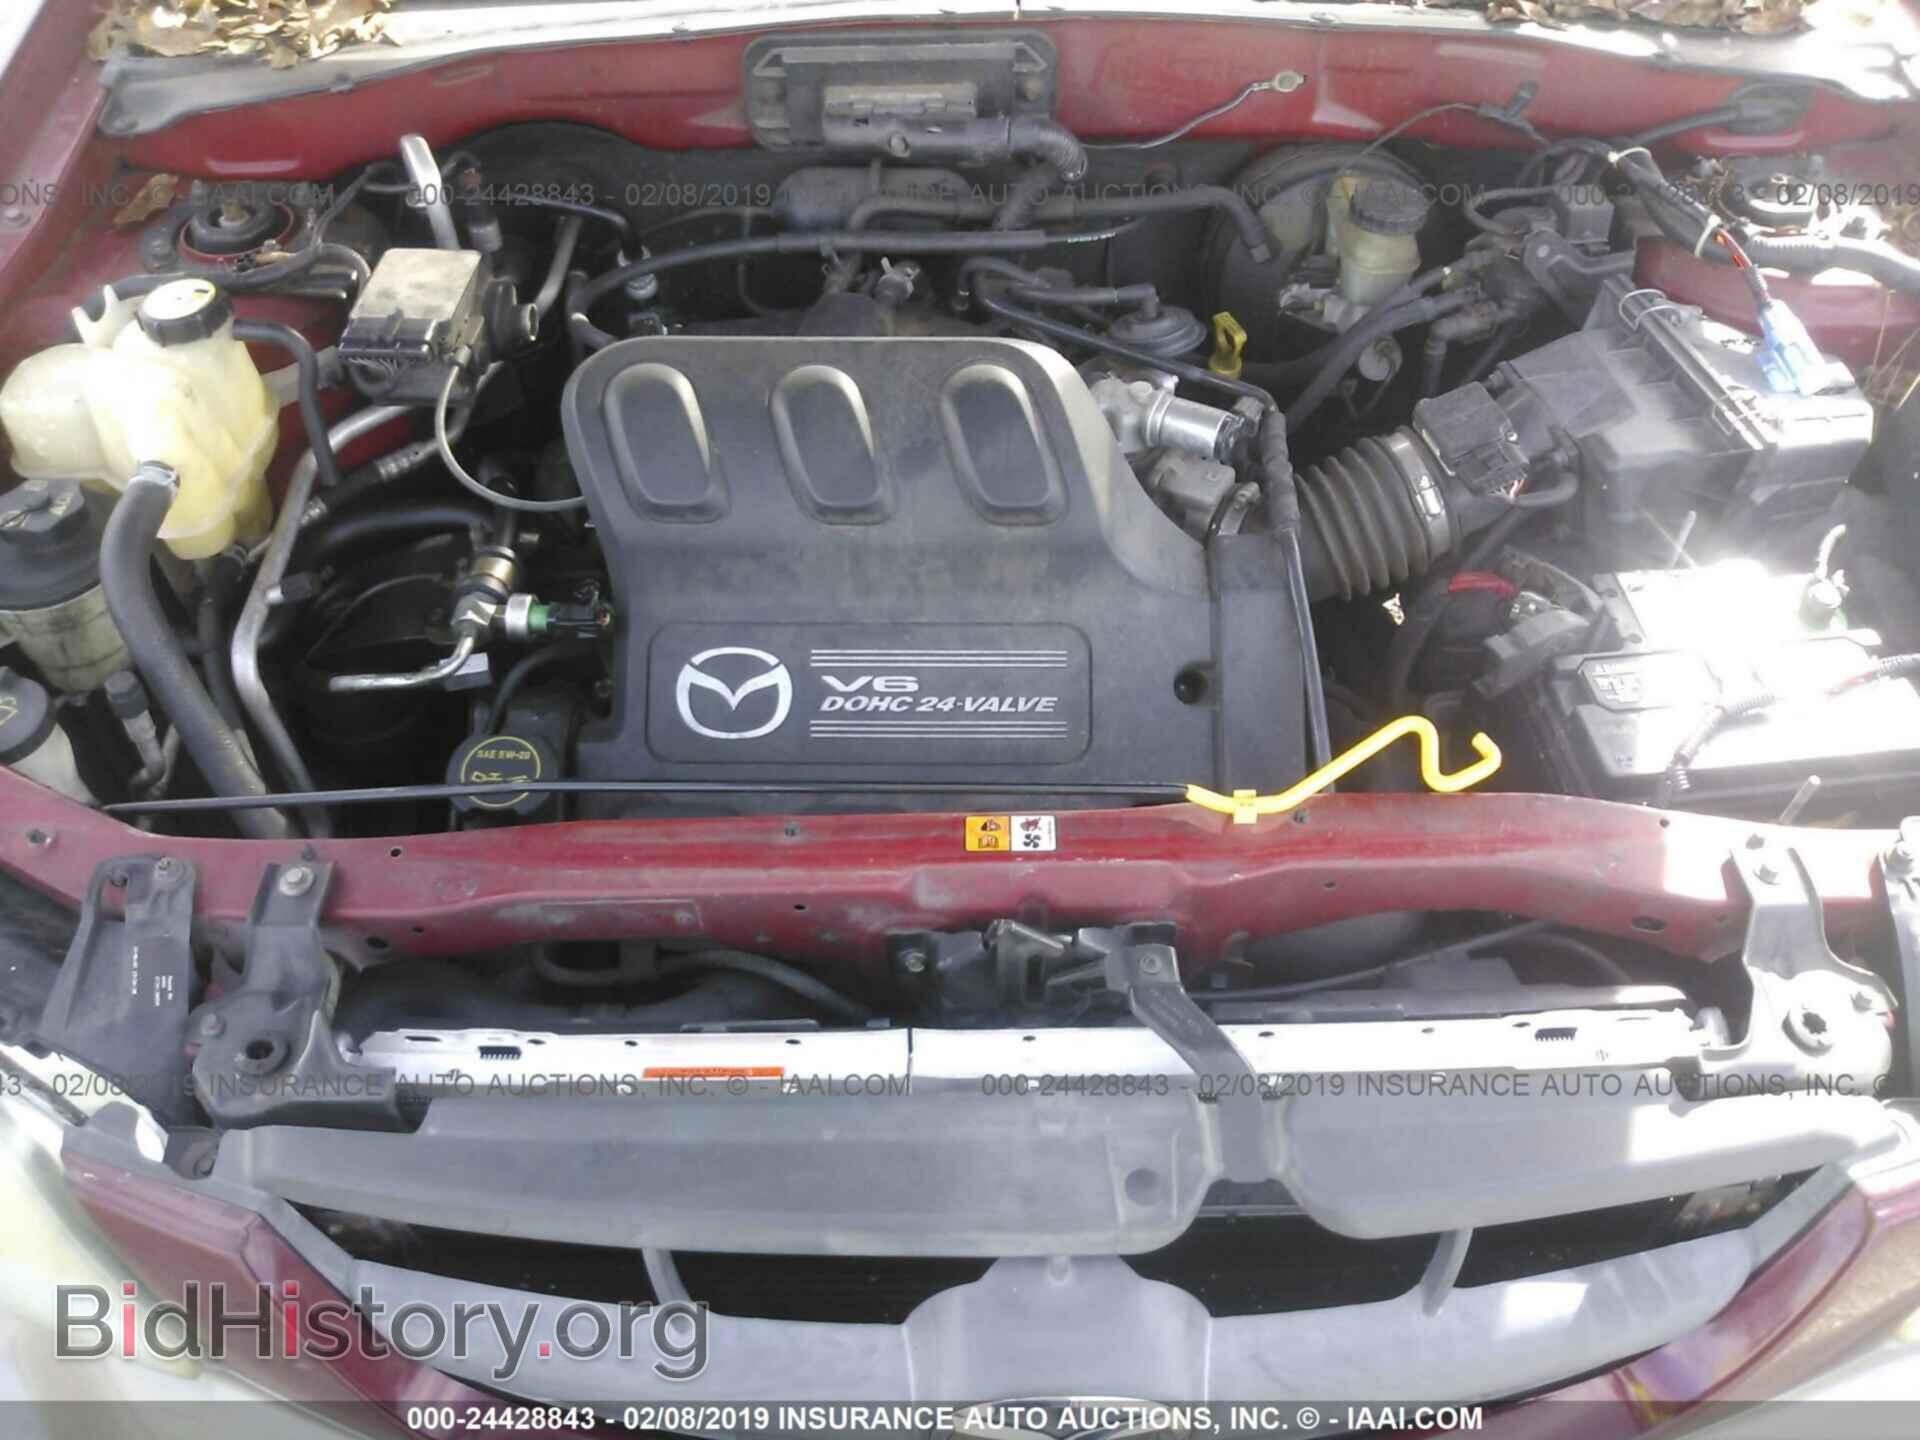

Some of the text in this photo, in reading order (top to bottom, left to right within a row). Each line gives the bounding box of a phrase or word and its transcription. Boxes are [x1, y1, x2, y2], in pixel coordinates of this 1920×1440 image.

[821, 675, 919, 693] V6
[820, 695, 1058, 713] DOHC 24-VALVE
